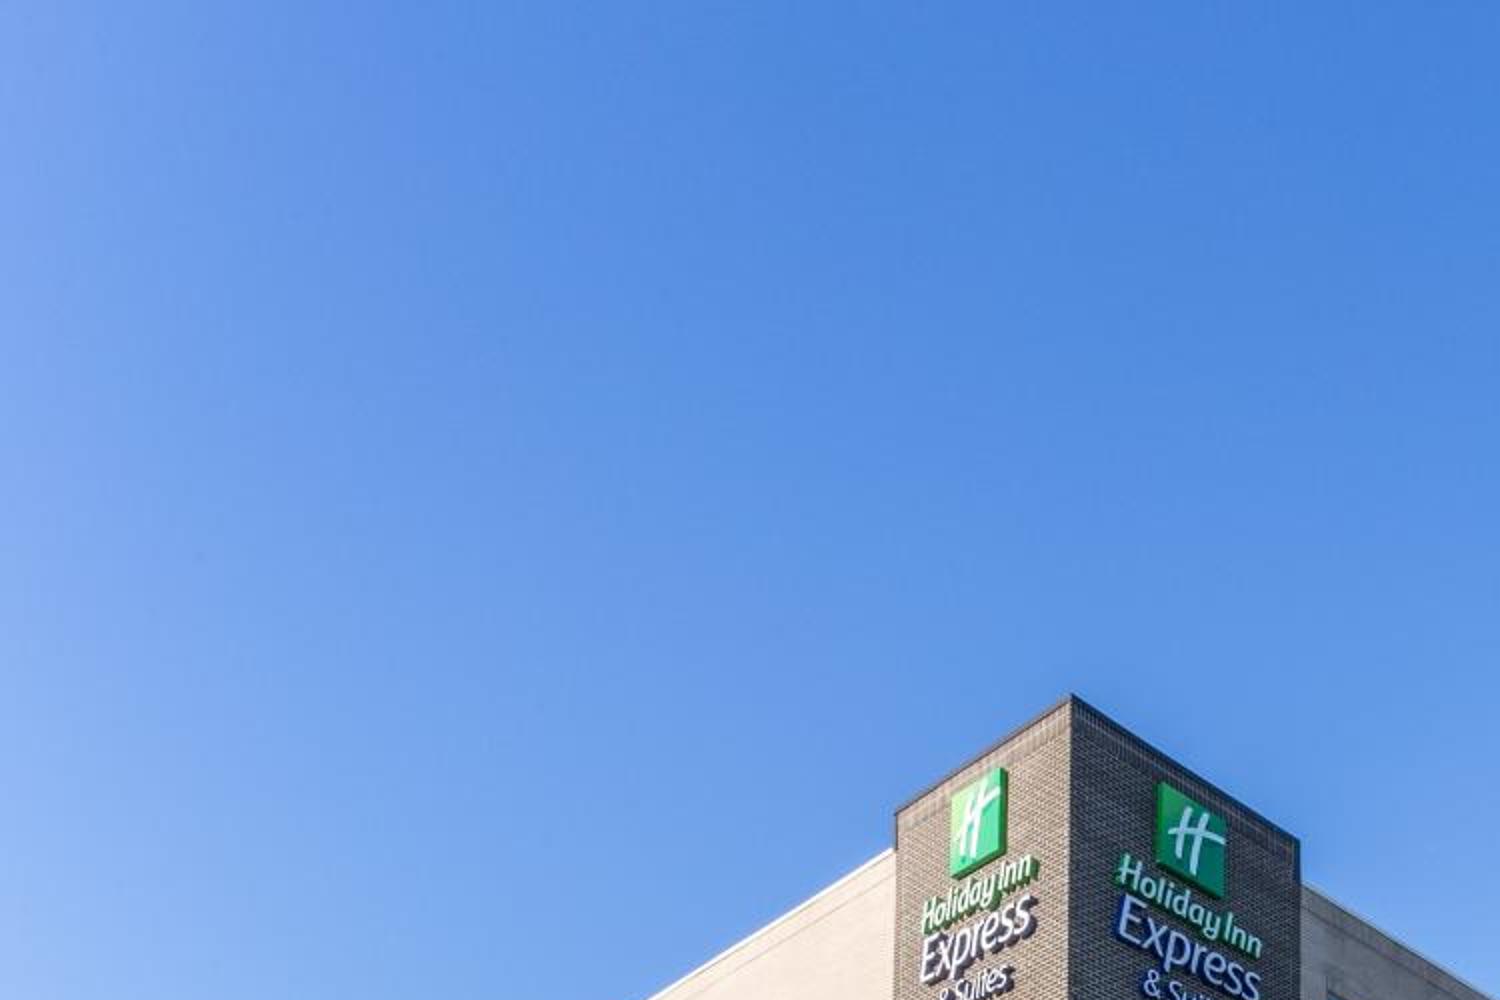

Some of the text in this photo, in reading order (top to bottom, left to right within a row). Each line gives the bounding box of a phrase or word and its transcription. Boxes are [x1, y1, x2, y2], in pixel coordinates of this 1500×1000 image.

[921, 854, 1032, 935] Holiday Inn
[1118, 853, 1263, 959] Holiday Inn
[920, 893, 1031, 984] Express
[1143, 969, 1161, 999] &
